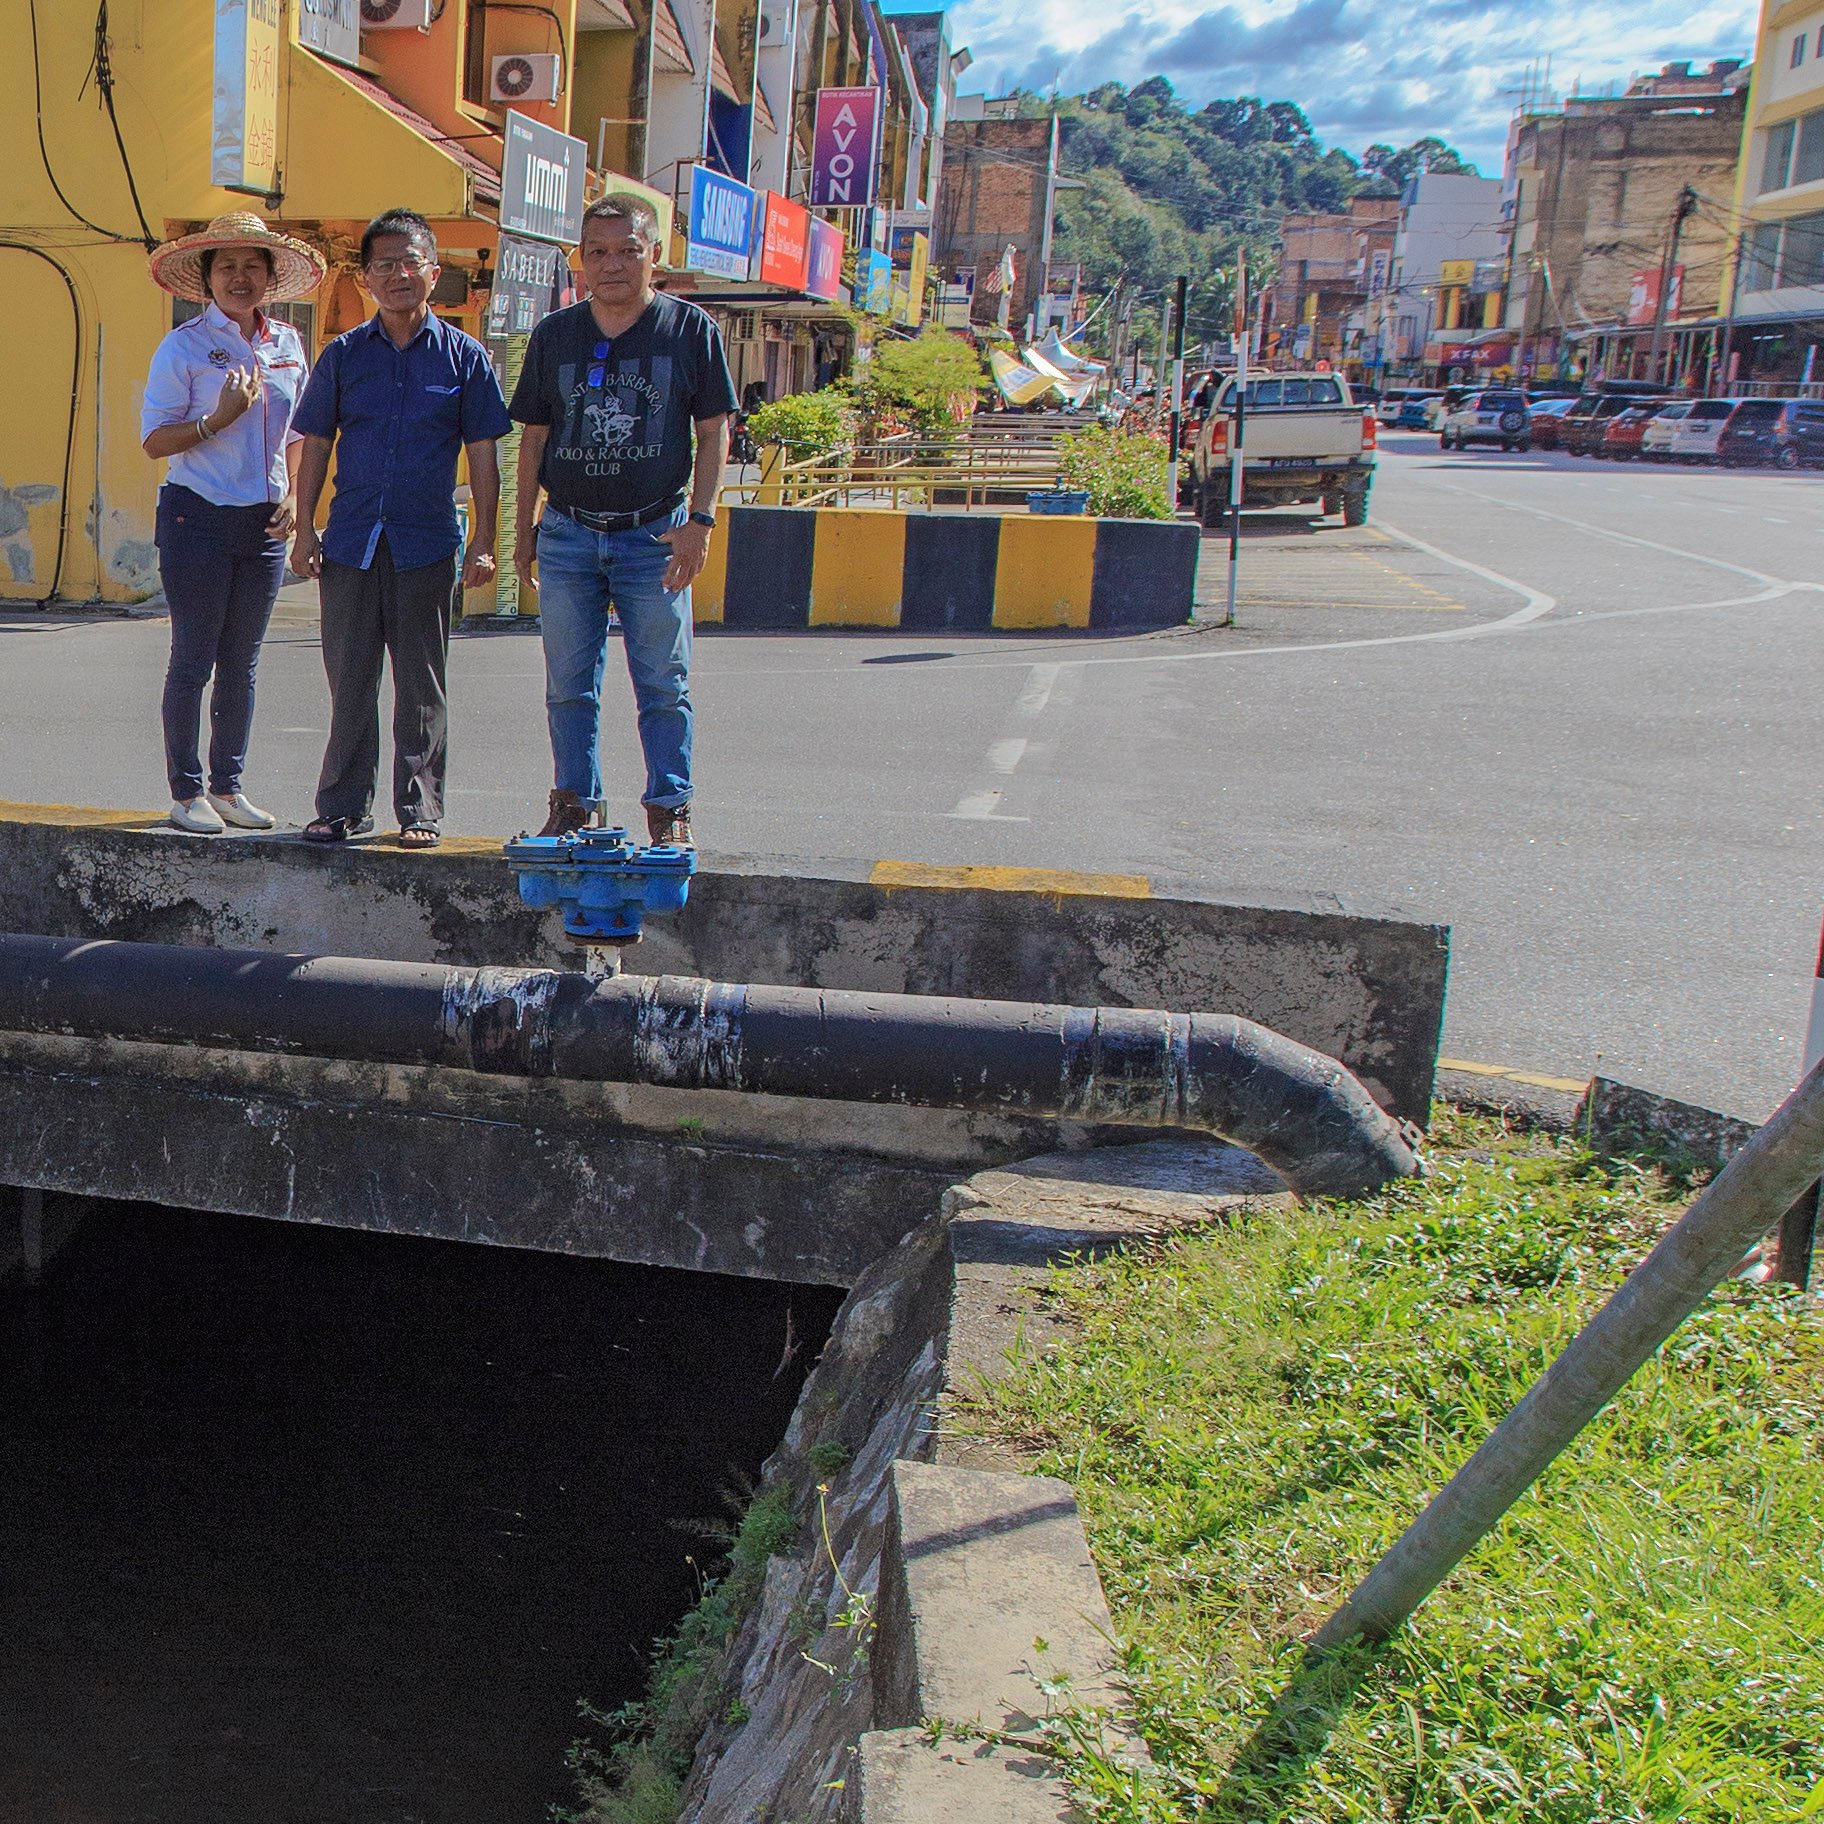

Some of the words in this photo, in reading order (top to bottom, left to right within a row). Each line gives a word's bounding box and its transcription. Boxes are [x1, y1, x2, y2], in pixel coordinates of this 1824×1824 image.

[249, 37, 276, 98] 永利
[828, 103, 858, 203] AVON
[701, 182, 748, 249] SAMSUNG
[605, 373, 665, 415] BARBARA
[555, 446, 583, 461] POLO
[584, 447, 595, 461] &
[598, 443, 664, 462] RACQUET
[585, 462, 621, 476] CLUB
